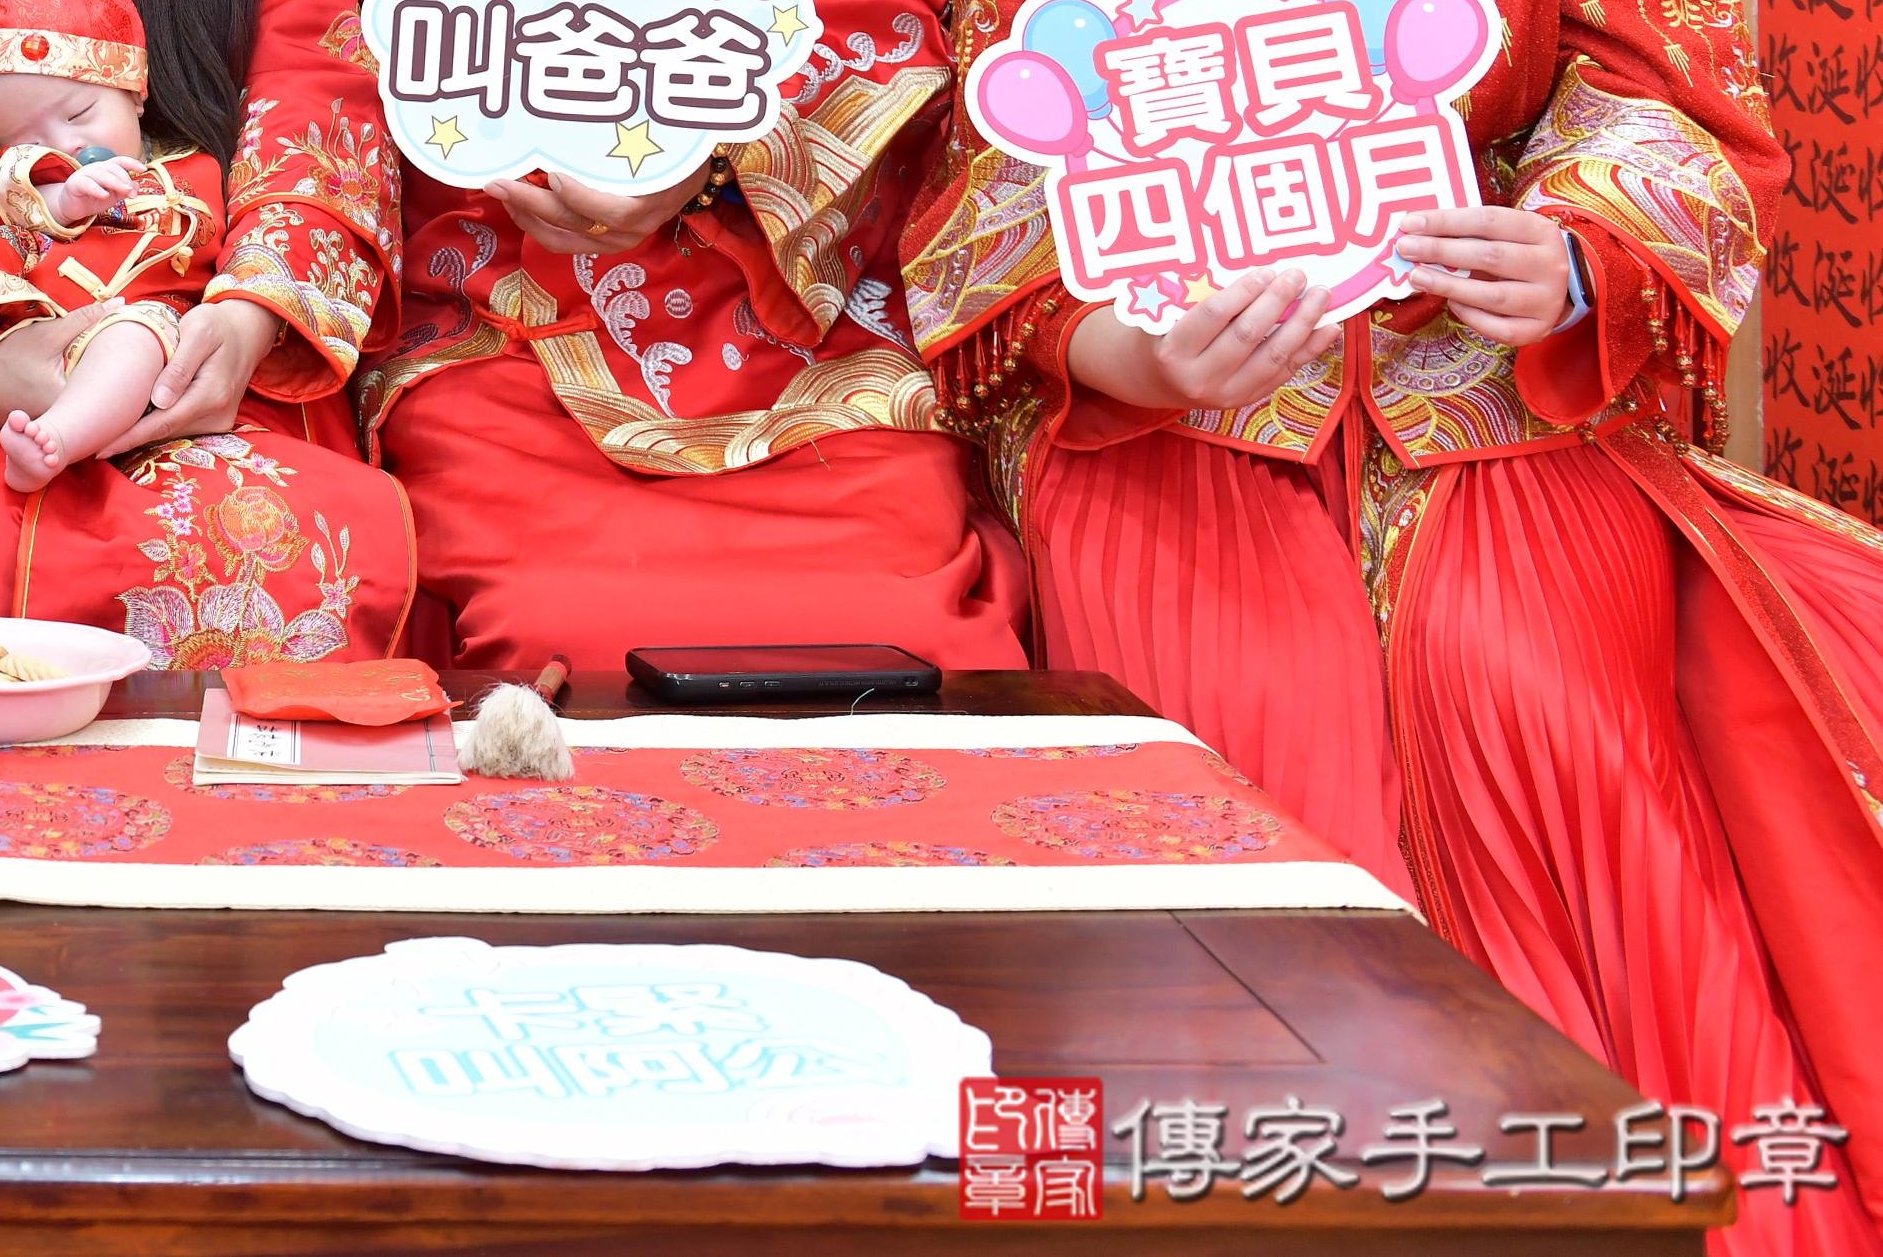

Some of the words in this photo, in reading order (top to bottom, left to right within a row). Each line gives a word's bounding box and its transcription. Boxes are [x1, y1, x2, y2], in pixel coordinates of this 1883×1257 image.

[1097, 3, 1380, 154] 寶貝
[1063, 118, 1463, 286] 四個月
